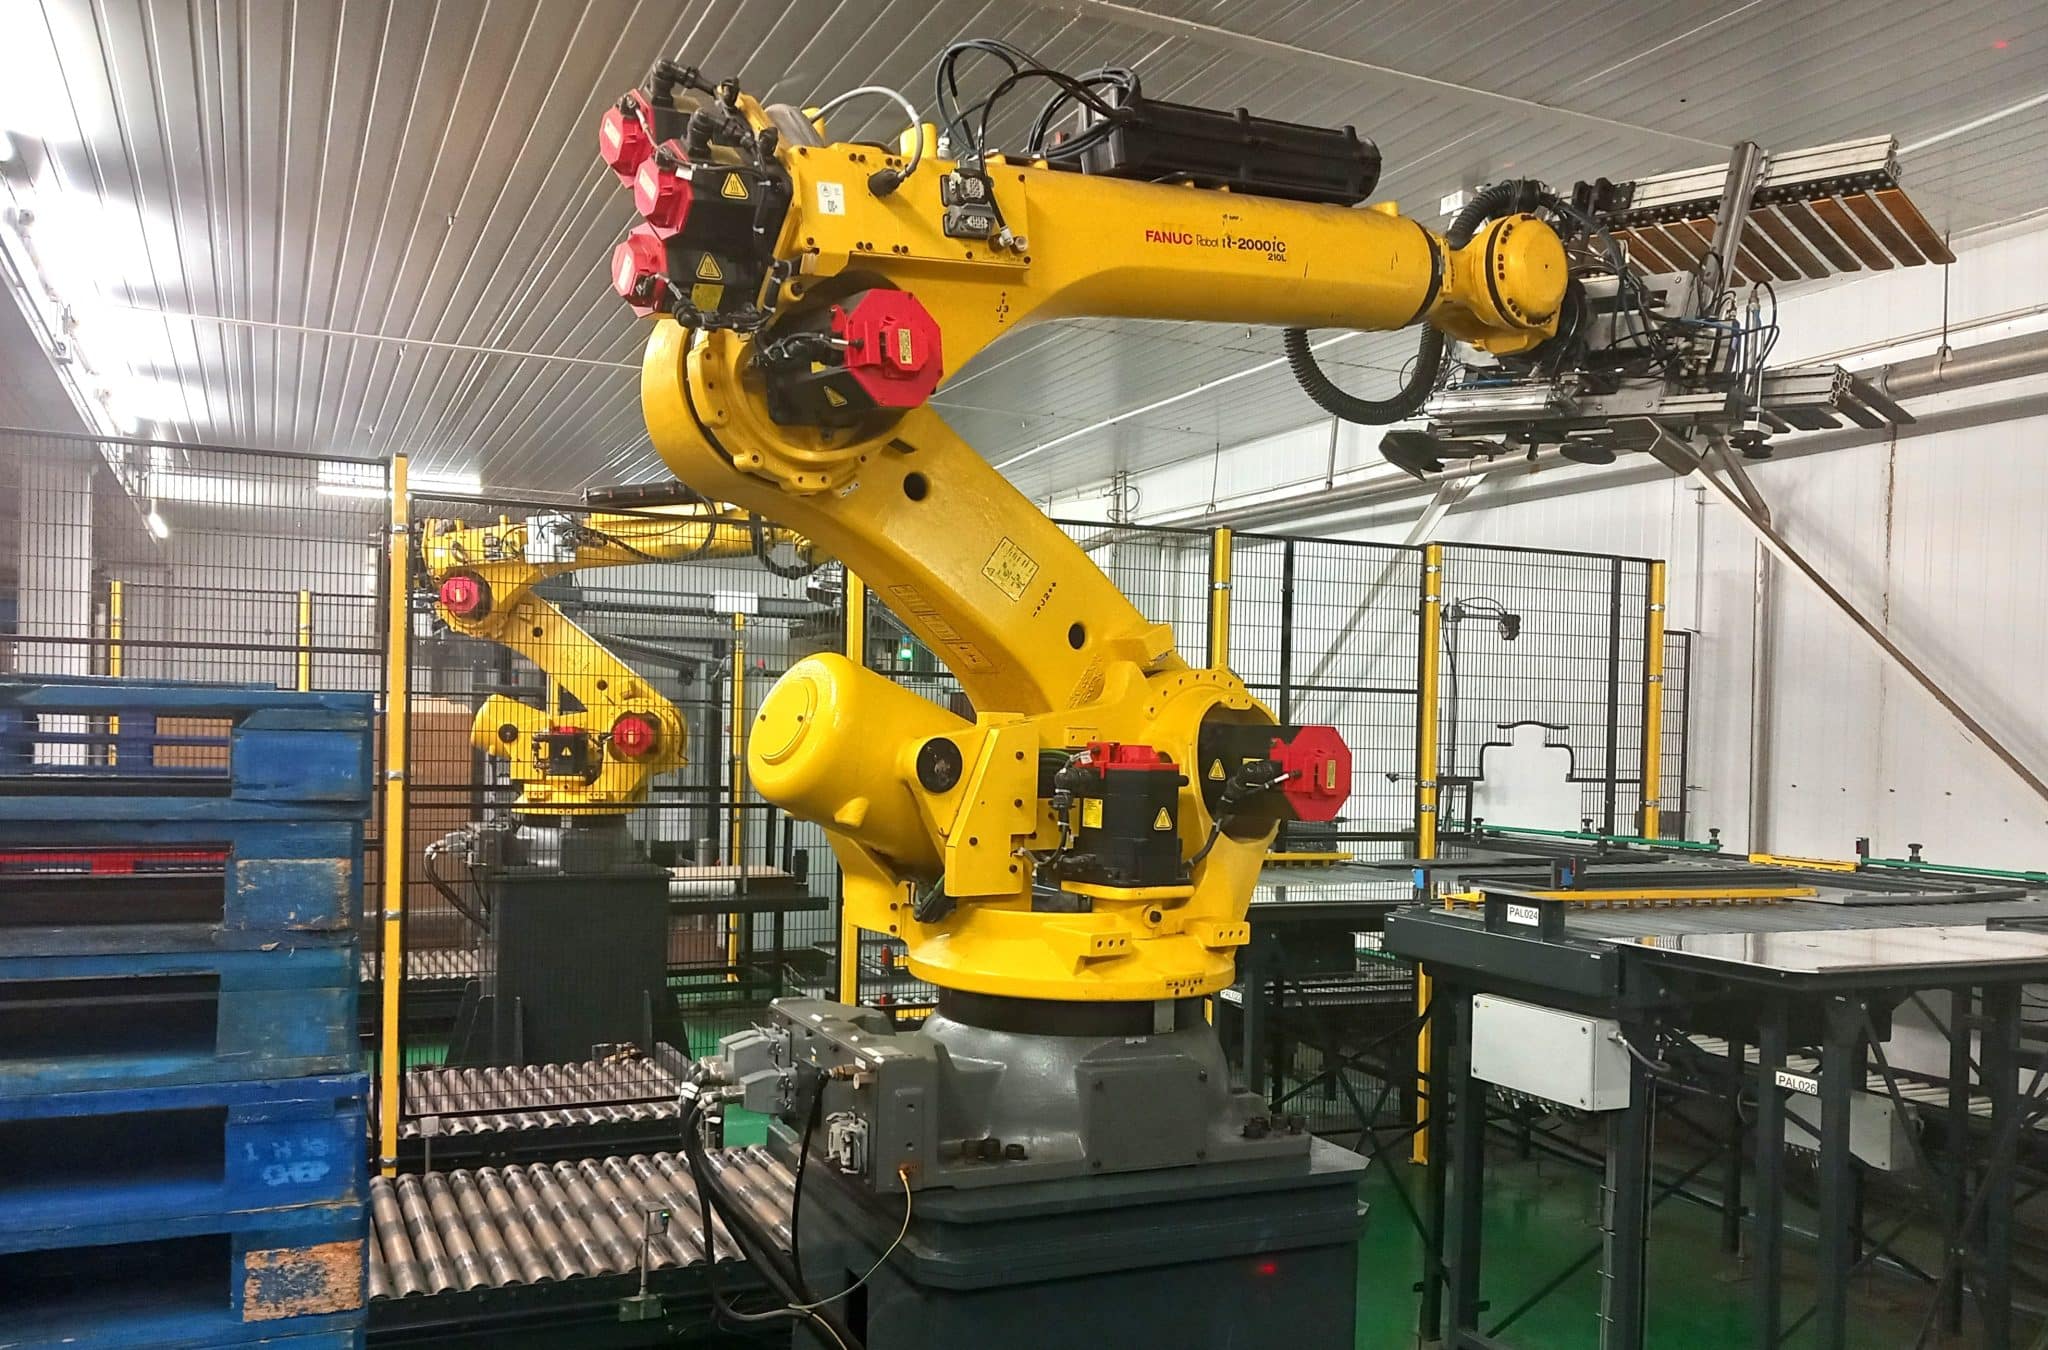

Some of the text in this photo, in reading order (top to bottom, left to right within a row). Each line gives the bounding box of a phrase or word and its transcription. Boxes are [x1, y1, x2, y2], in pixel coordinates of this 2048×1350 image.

[1145, 230, 1193, 246] FANUC
[1267, 253, 1287, 262] 210L
[1509, 906, 1538, 920] PAL024
[1778, 1075, 1817, 1094] PAL026
